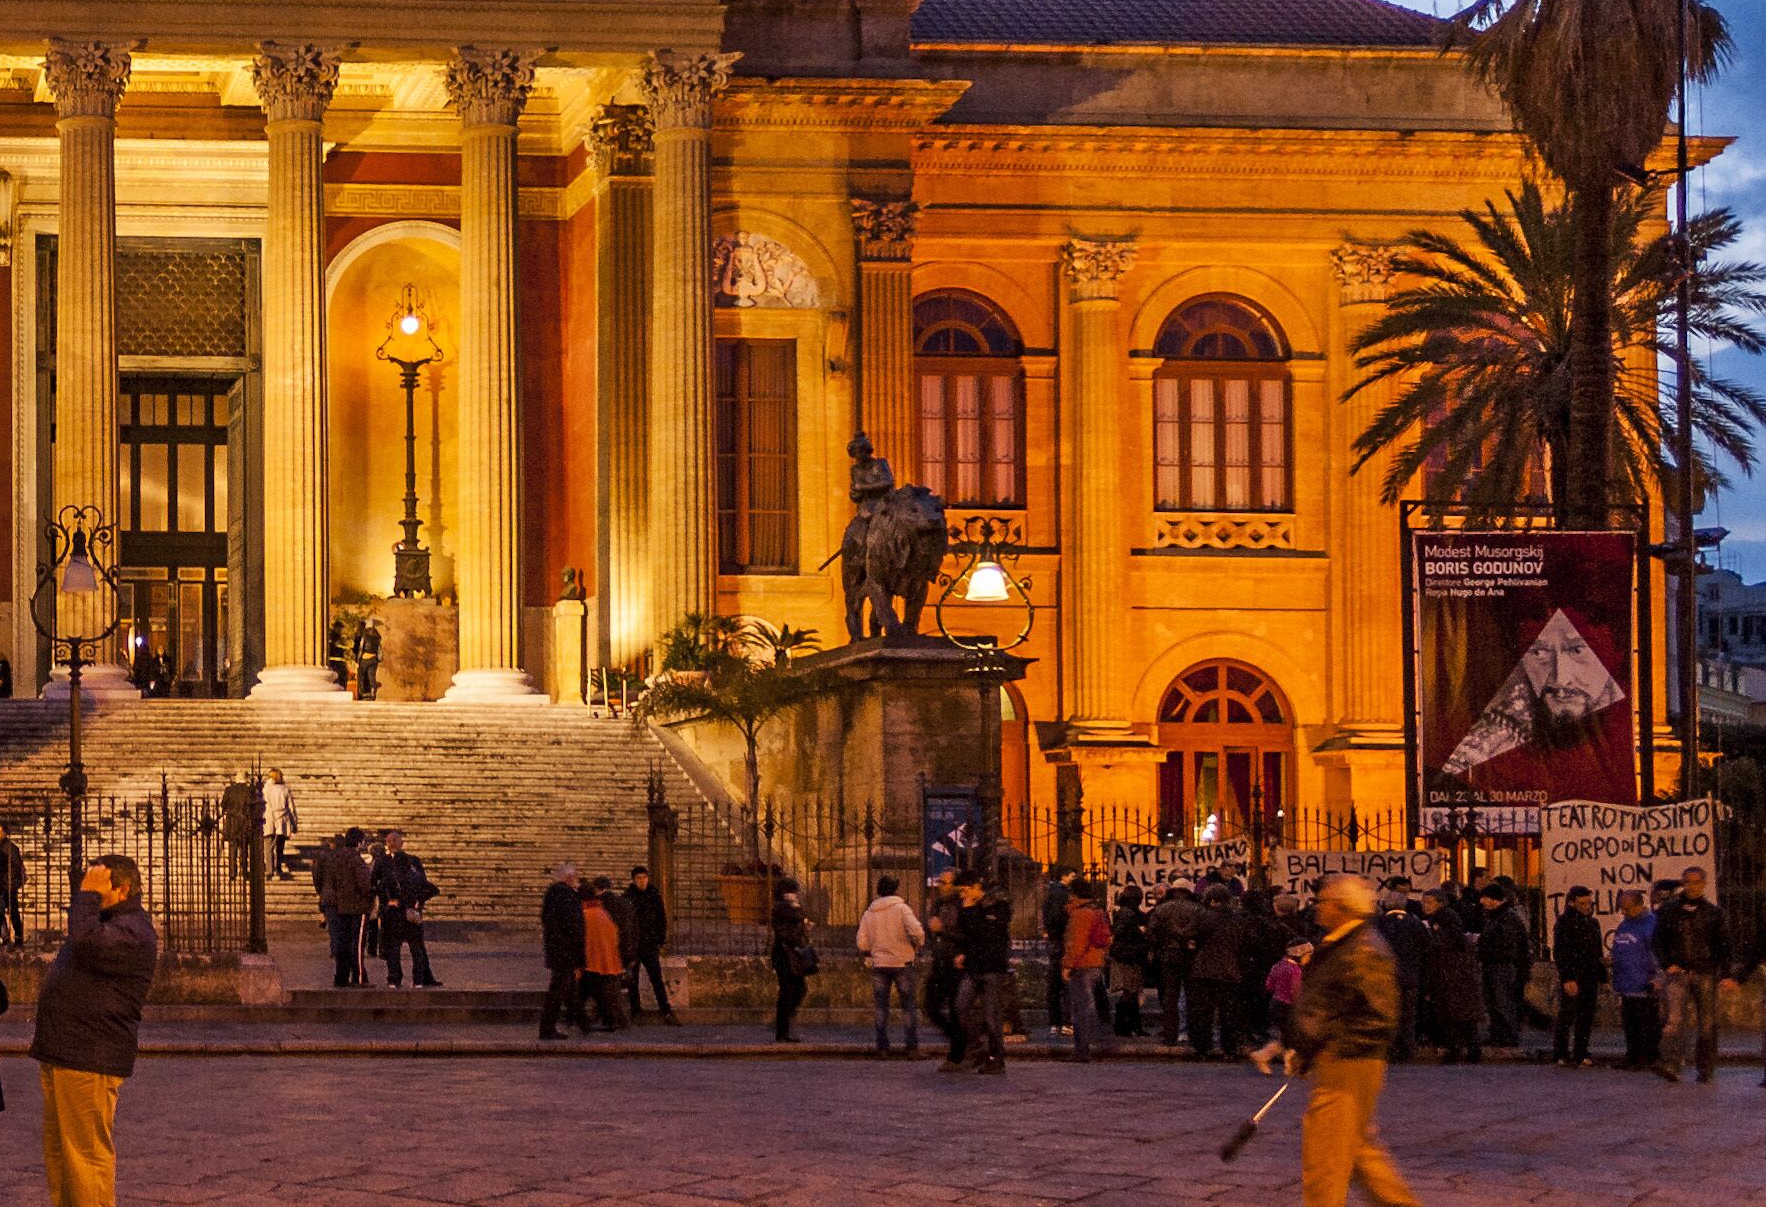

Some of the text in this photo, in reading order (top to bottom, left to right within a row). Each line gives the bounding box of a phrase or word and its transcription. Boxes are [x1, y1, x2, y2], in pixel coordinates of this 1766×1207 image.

[1424, 544, 1544, 561] Modest Musorgskij
[1425, 562, 1544, 575] BORIS GODUNOV
[1463, 578, 1495, 588] George
[1450, 589, 1472, 598] Hugo
[1487, 588, 1505, 596] Ana
[1489, 791, 1504, 802] 30
[1506, 791, 1548, 802] MARZO
[1541, 802, 1710, 831] TEATRO MASSIMO
[1114, 840, 1247, 866] APPLICHIAMO
[1551, 836, 1620, 863] CORPO
[1636, 833, 1710, 859] BALLO
[1287, 852, 1433, 876] BALLIAMO
[1110, 870, 1137, 886] LA
[1600, 863, 1653, 885] NON
